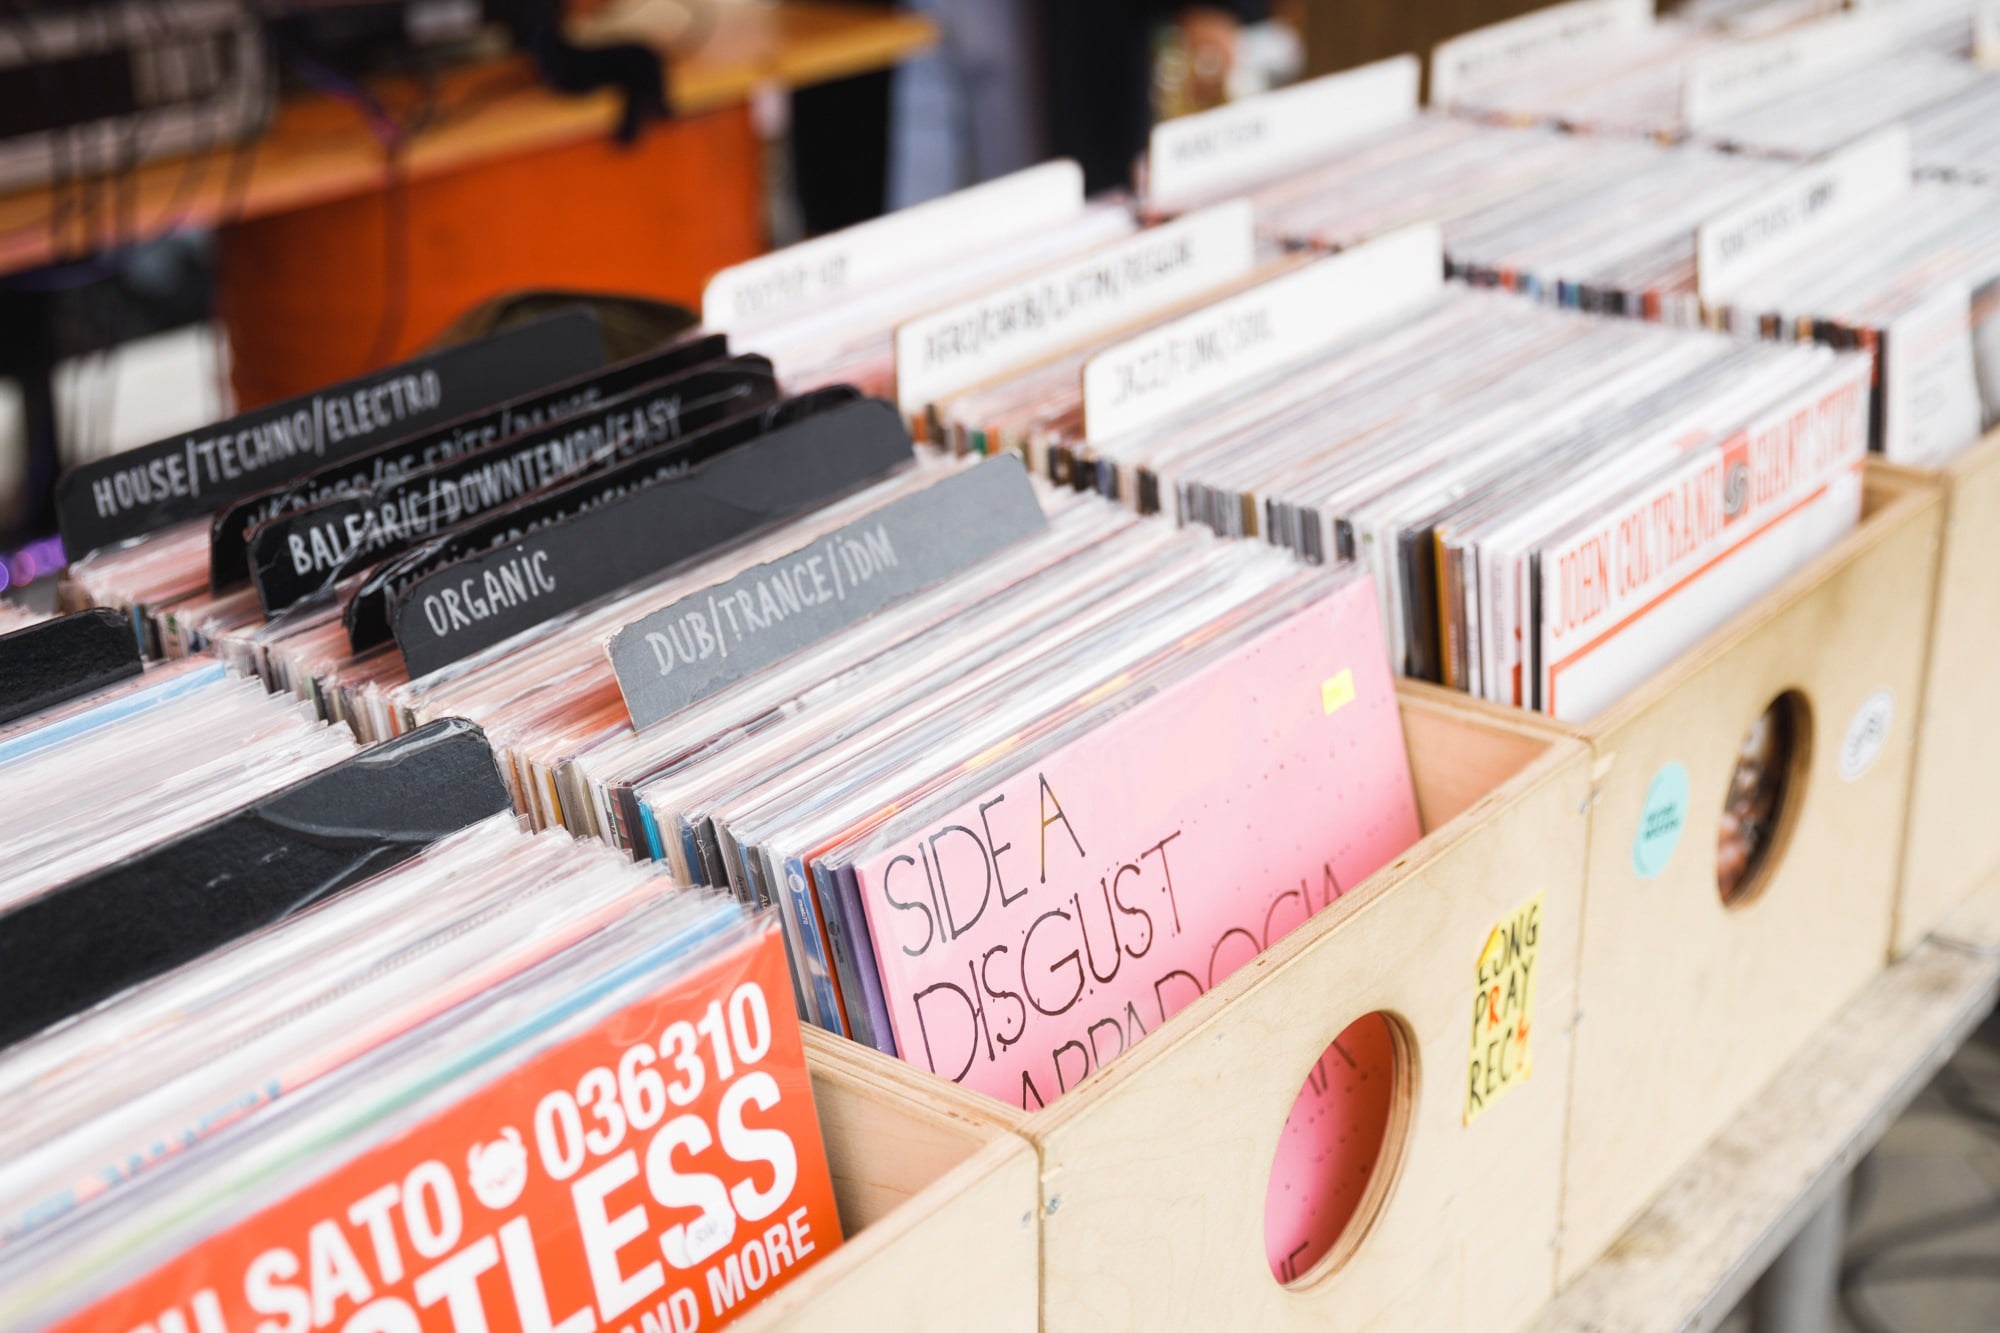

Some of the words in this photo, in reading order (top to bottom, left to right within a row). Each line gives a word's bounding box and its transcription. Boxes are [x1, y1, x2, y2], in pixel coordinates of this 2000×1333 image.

[92, 369, 443, 519] HOUSE/TECHNO/ELECTRO
[884, 794, 1029, 956] SIDE
[1039, 771, 1086, 884] A
[912, 830, 1181, 1083] DISGUST
[1473, 954, 1534, 1048] PRAY
[244, 1159, 463, 1333] SATO
[533, 981, 774, 1182] 036310
[705, 1205, 816, 1318] MORE
